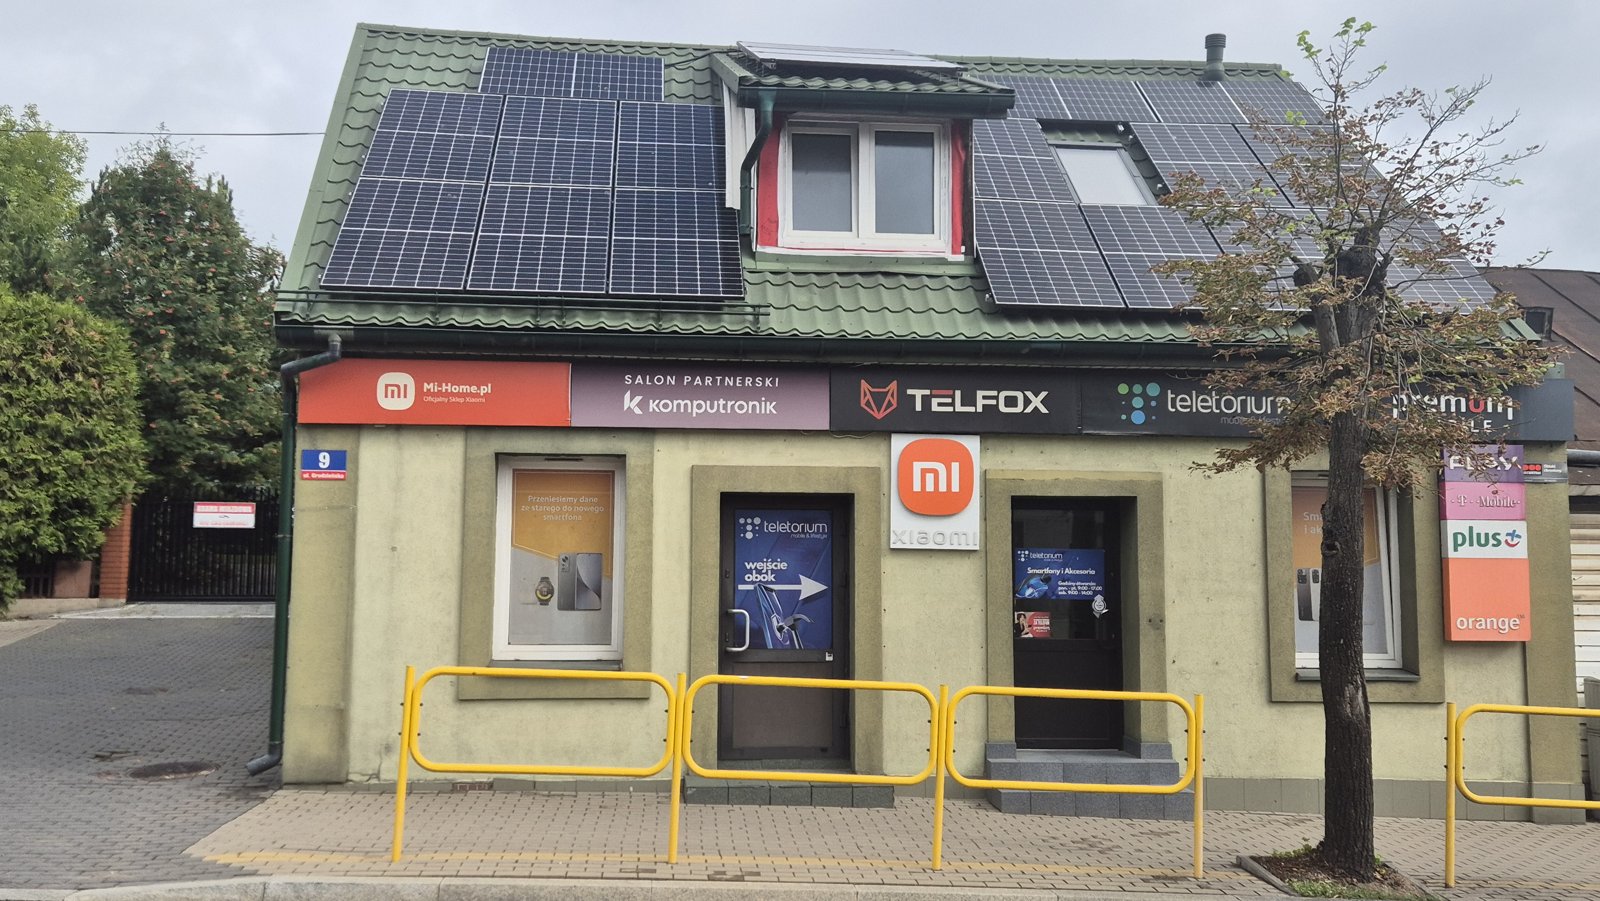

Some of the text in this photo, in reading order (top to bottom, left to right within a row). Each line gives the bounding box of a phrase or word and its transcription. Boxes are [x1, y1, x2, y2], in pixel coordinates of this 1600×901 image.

[624, 374, 779, 388] SALON PARTNERSKI
[423, 382, 492, 395] Mi-Home.pl
[649, 397, 777, 417] komputronik
[906, 388, 1050, 414] TELFOX
[318, 451, 330, 469] 9
[527, 495, 577, 503] Przeniesiemy
[531, 505, 561, 513] starego
[543, 513, 582, 521] smartfona
[764, 520, 828, 533] teletorium
[892, 529, 977, 547] xiaomi
[1452, 525, 1501, 553] plus
[1029, 551, 1063, 559] teletorium
[744, 558, 788, 573] wejście
[1027, 567, 1061, 576] Smartfony
[1064, 567, 1096, 575] Akcesoria
[744, 570, 776, 582] obok
[1455, 615, 1520, 634] orange
